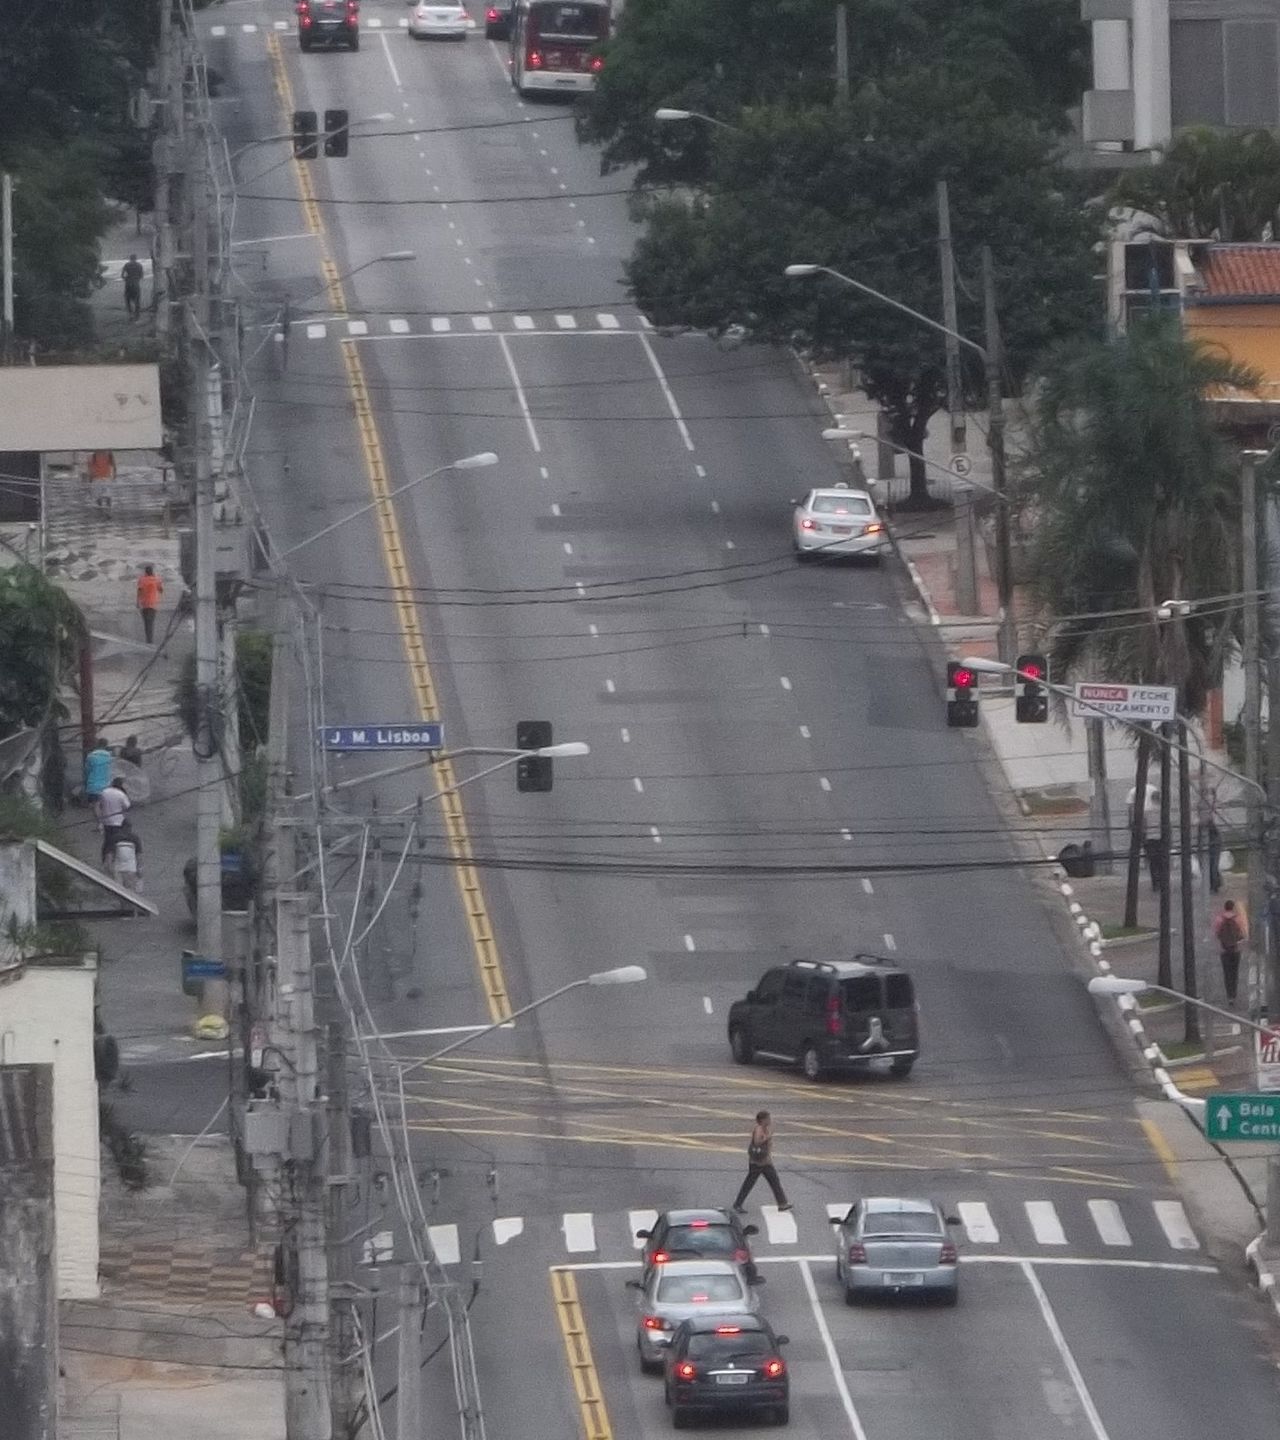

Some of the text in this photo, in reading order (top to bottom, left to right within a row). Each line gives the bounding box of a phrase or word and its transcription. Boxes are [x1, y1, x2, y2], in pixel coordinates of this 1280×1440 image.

[1082, 688, 1169, 700] NUNCA FECHE
[331, 730, 431, 744] J. M. Lisboa
[1239, 1103, 1275, 1117] Bela
